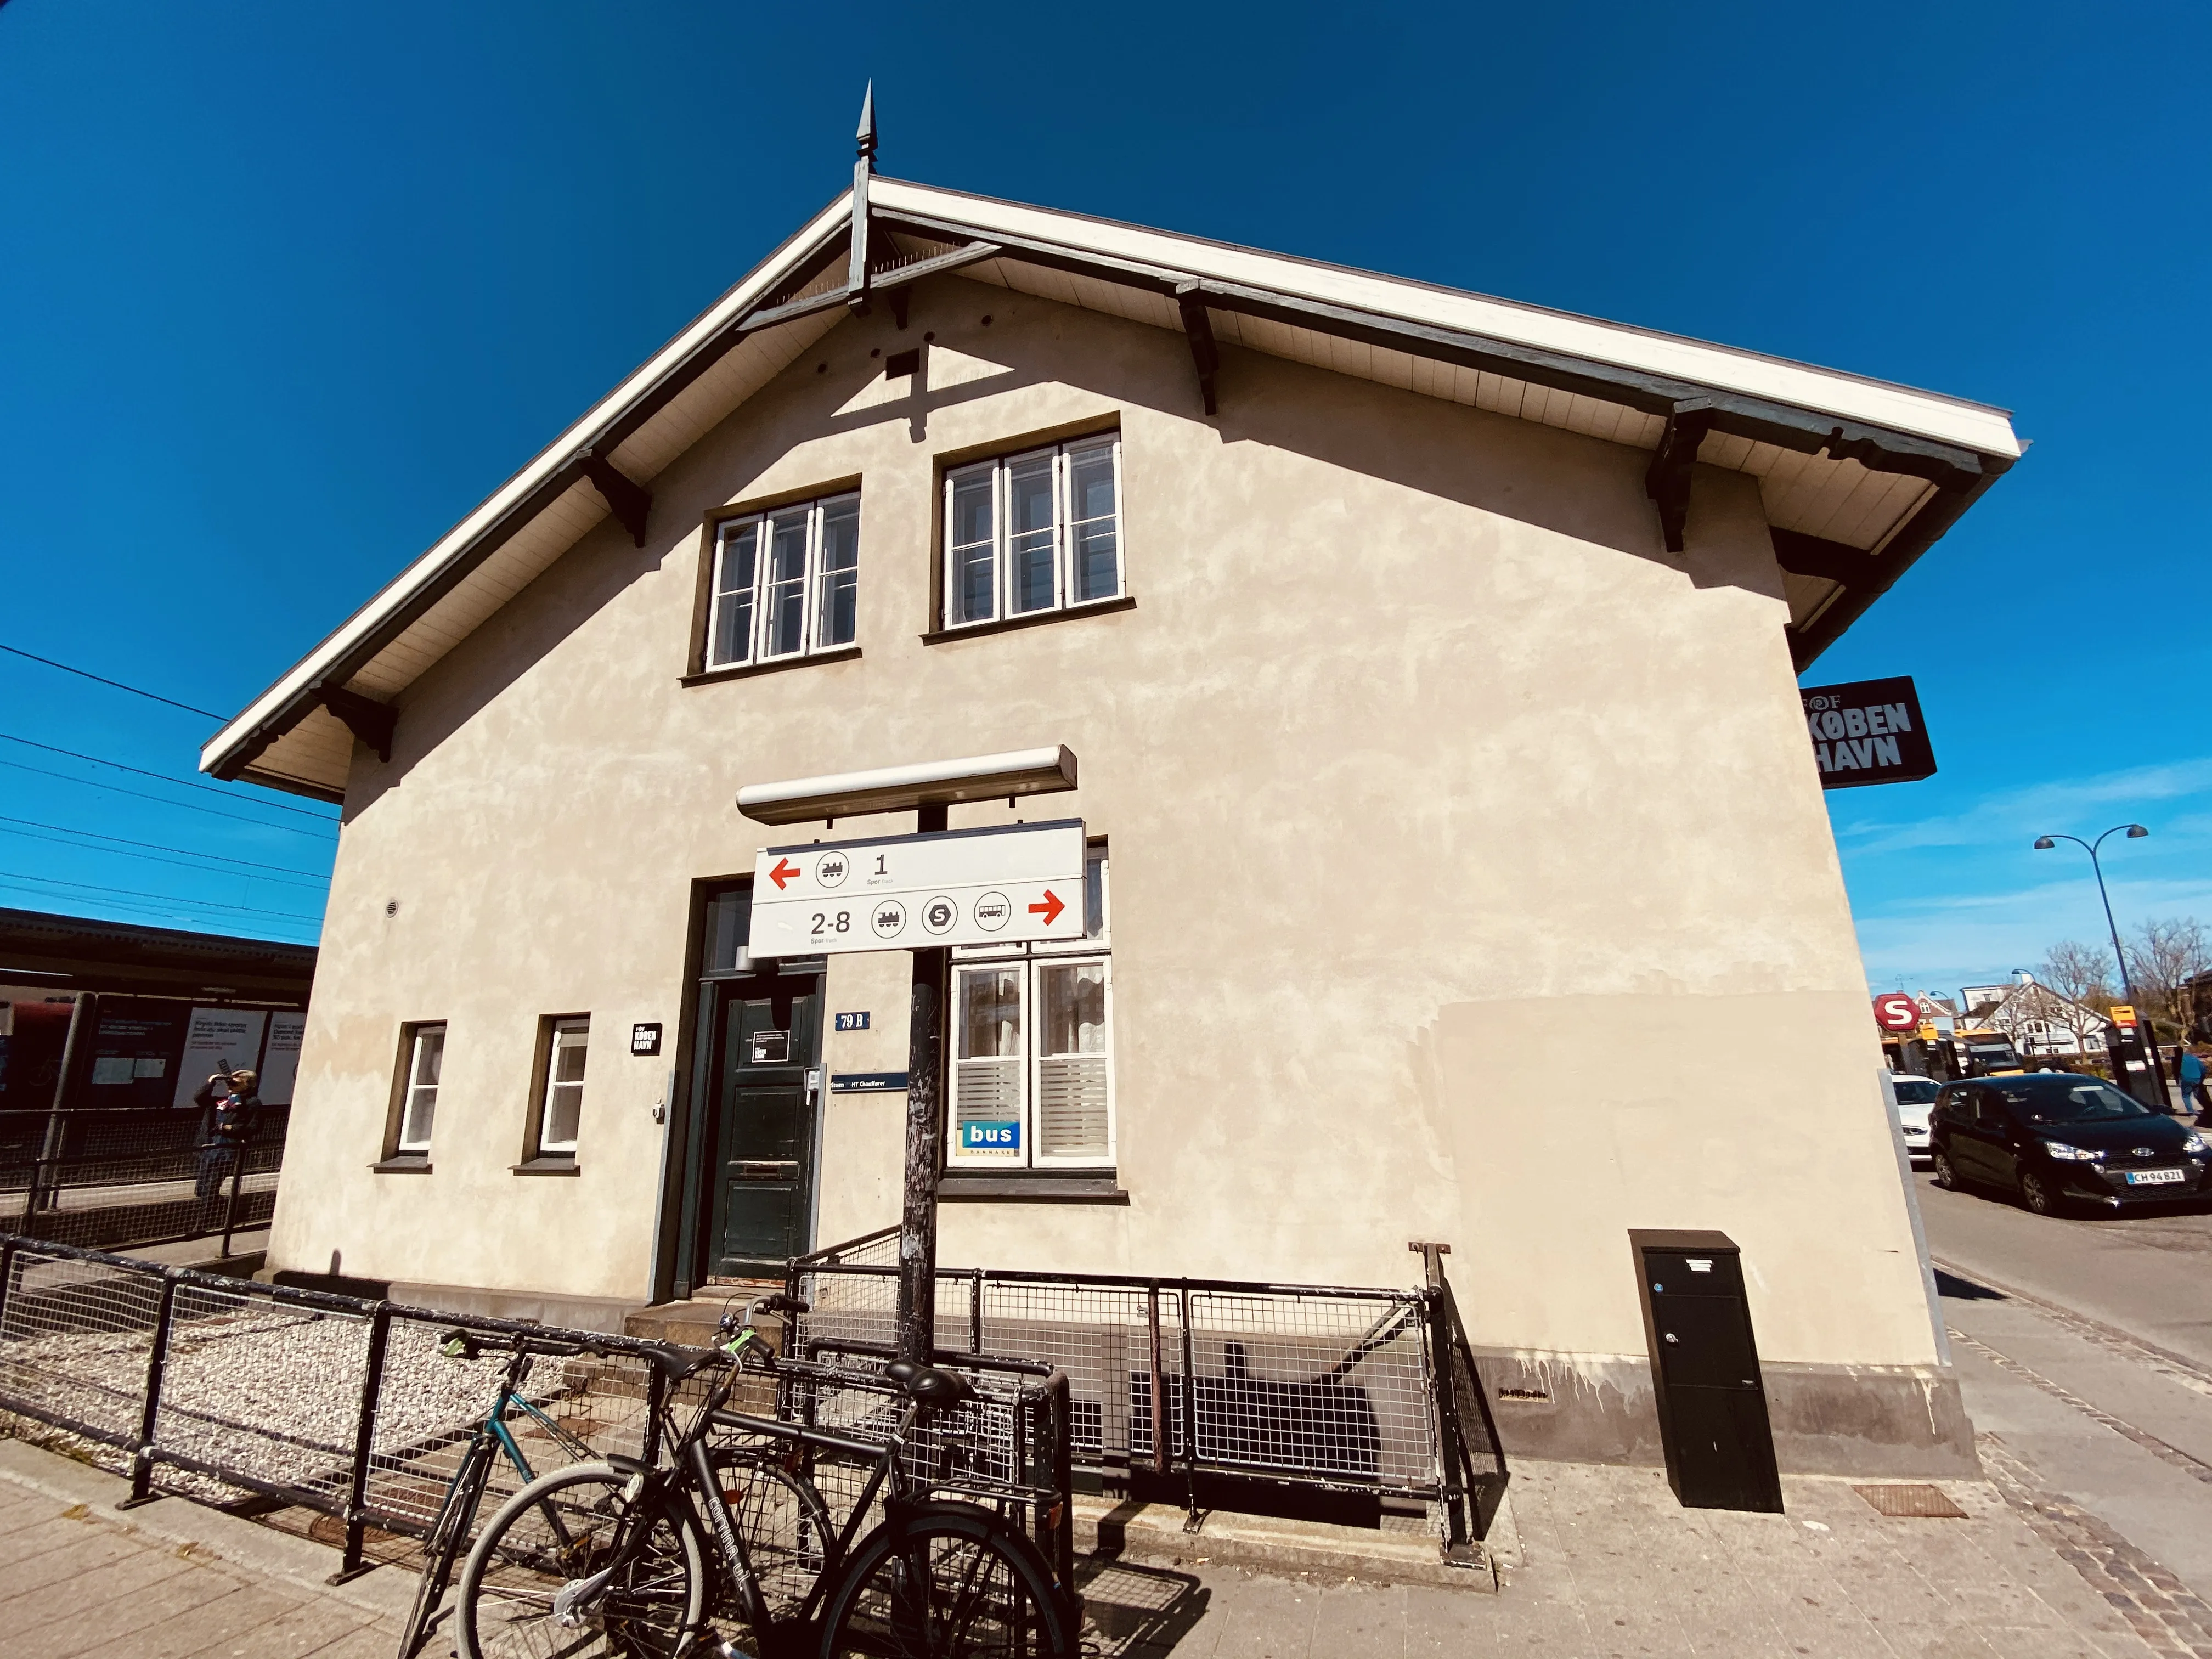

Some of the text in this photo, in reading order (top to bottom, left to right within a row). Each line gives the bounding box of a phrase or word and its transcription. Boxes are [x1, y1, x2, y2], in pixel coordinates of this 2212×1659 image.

[1805, 703, 1911, 741] KØBEN
[1813, 736, 1902, 772] HAVN
[874, 854, 888, 876] 1
[811, 911, 850, 934] 2-8
[934, 909, 945, 922] S
[841, 1013, 863, 1028] 79 B
[1884, 1000, 1912, 1025] S
[634, 1040, 652, 1050] HAVN
[970, 1125, 1012, 1142] bus
